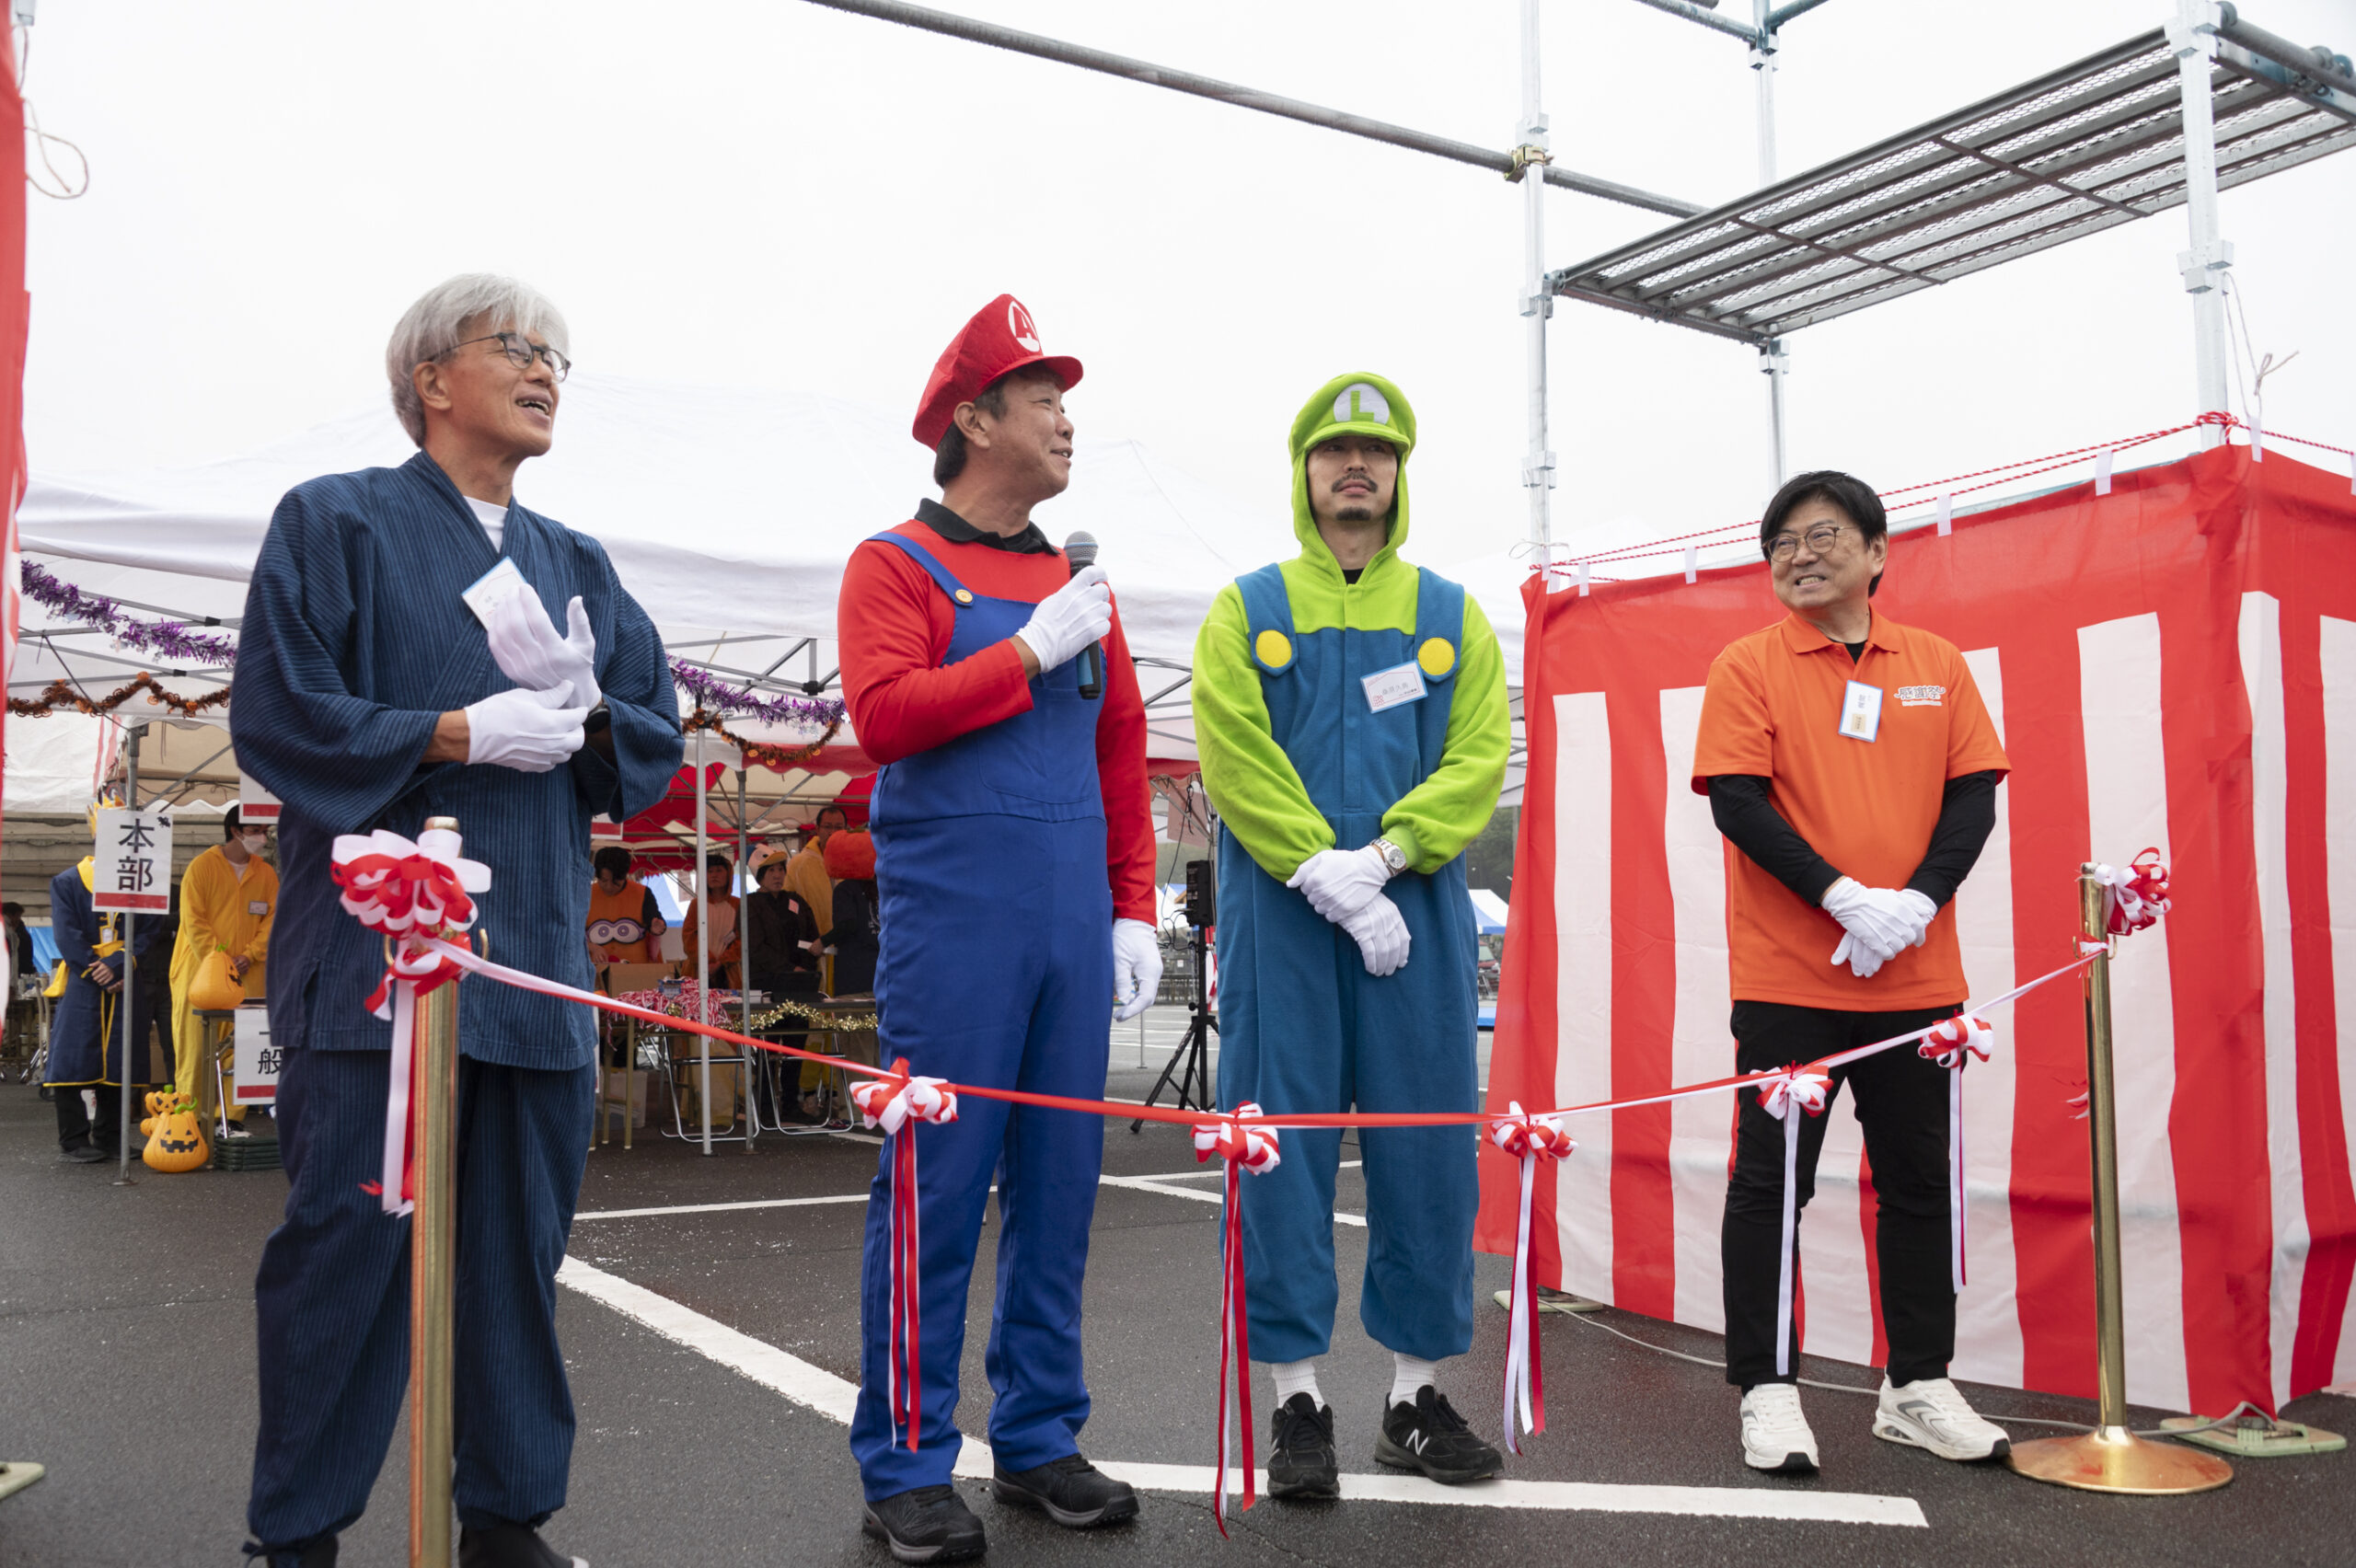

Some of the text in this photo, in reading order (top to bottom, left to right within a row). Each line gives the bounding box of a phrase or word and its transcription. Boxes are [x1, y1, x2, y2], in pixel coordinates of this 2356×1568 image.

[1350, 390, 1375, 422] L
[117, 818, 155, 892] 本部
[1405, 1428, 1429, 1456] N
